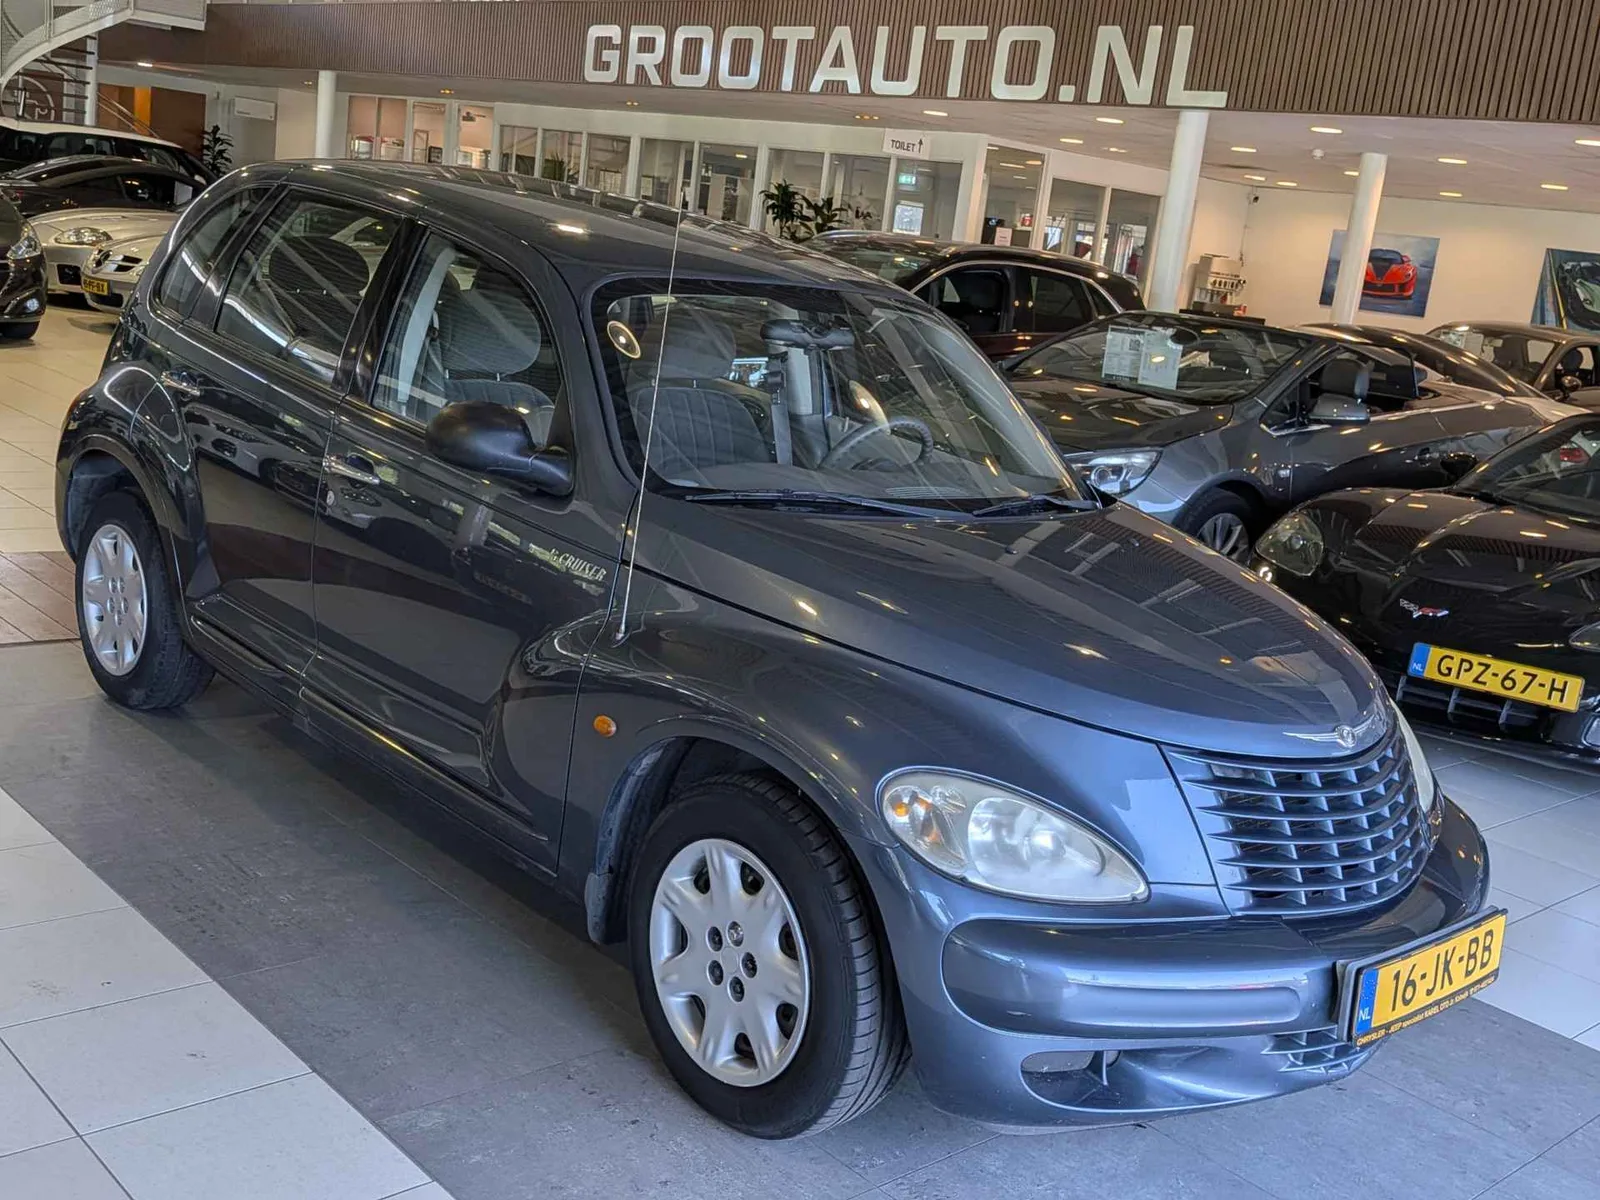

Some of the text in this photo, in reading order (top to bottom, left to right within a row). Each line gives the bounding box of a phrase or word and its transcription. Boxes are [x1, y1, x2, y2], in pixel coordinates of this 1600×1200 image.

[583, 24, 1228, 108] GROOTAUTO.NL
[890, 138, 916, 153] TOILET
[560, 553, 607, 581] CRUISER
[1411, 661, 1424, 672] NL
[1436, 654, 1569, 704] GPZ-67-H
[1390, 928, 1494, 1013] 16-JK-BB
[1358, 1006, 1371, 1022] NL
[1356, 1029, 1385, 1046] CHRYSLER
[1388, 1021, 1403, 1034] JEEP
